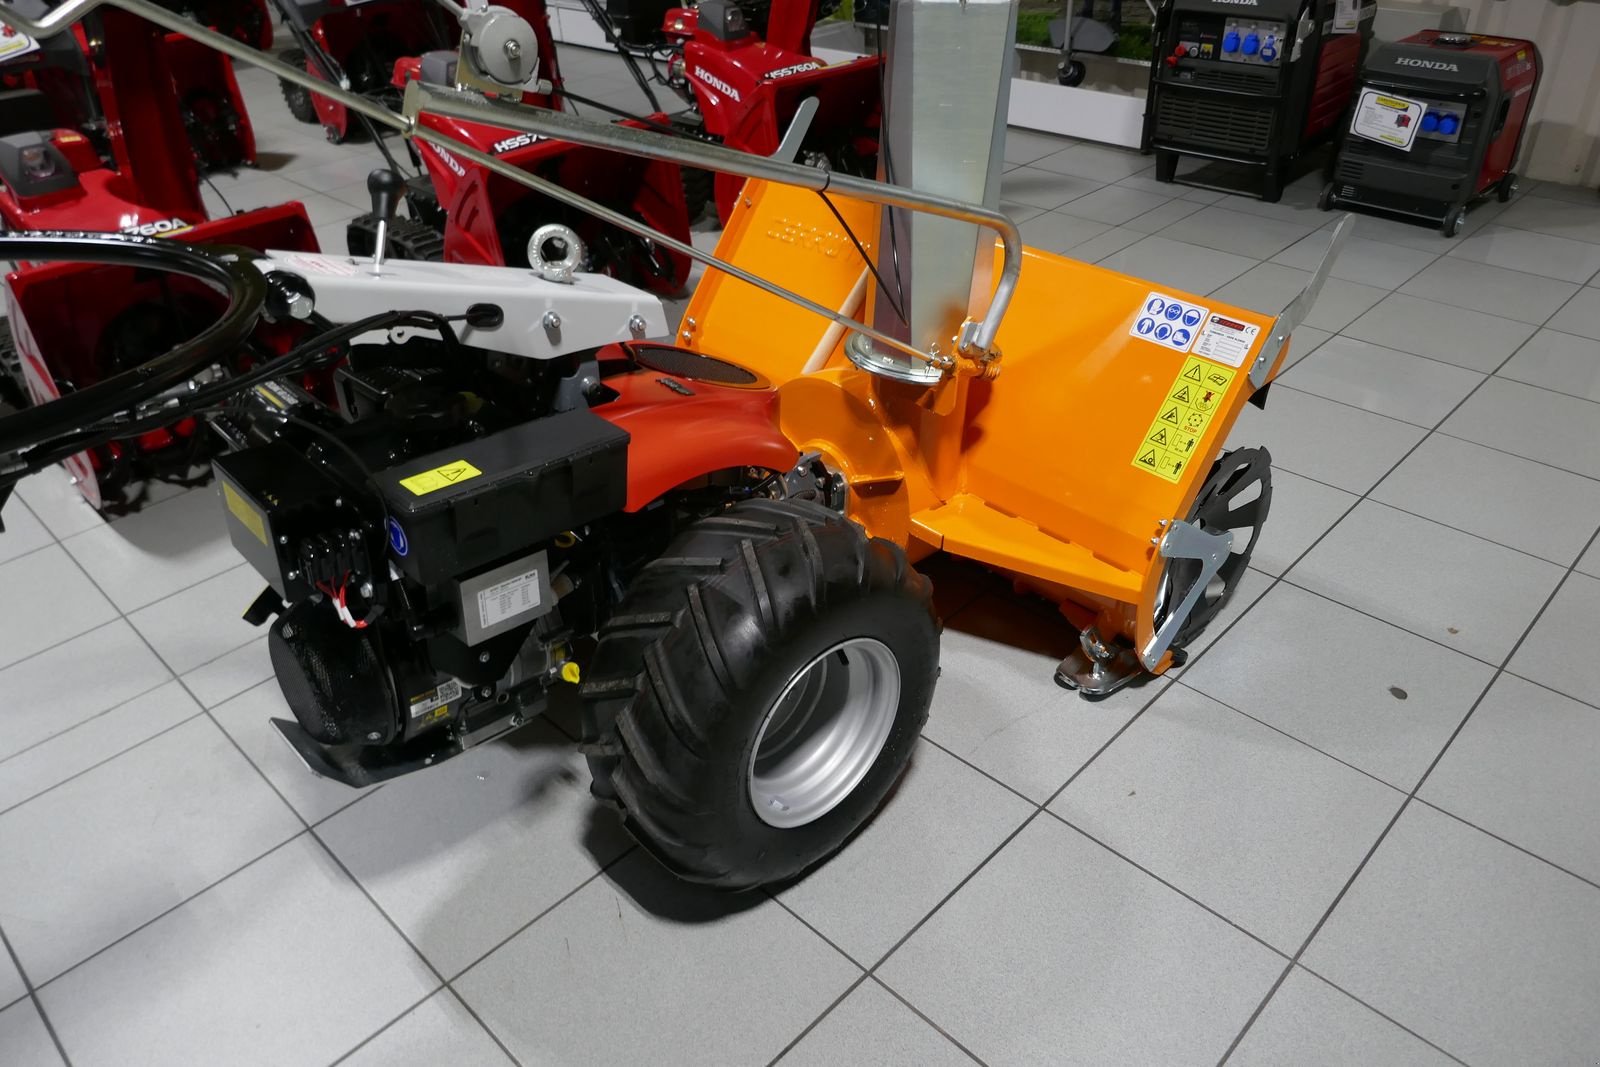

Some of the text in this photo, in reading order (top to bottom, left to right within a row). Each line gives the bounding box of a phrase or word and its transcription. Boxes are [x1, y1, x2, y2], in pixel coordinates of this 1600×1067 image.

[1394, 57, 1459, 72] HONDA
[694, 65, 741, 102] HONDA
[427, 141, 466, 177] ONDA
[1183, 425, 1198, 434] STOP
